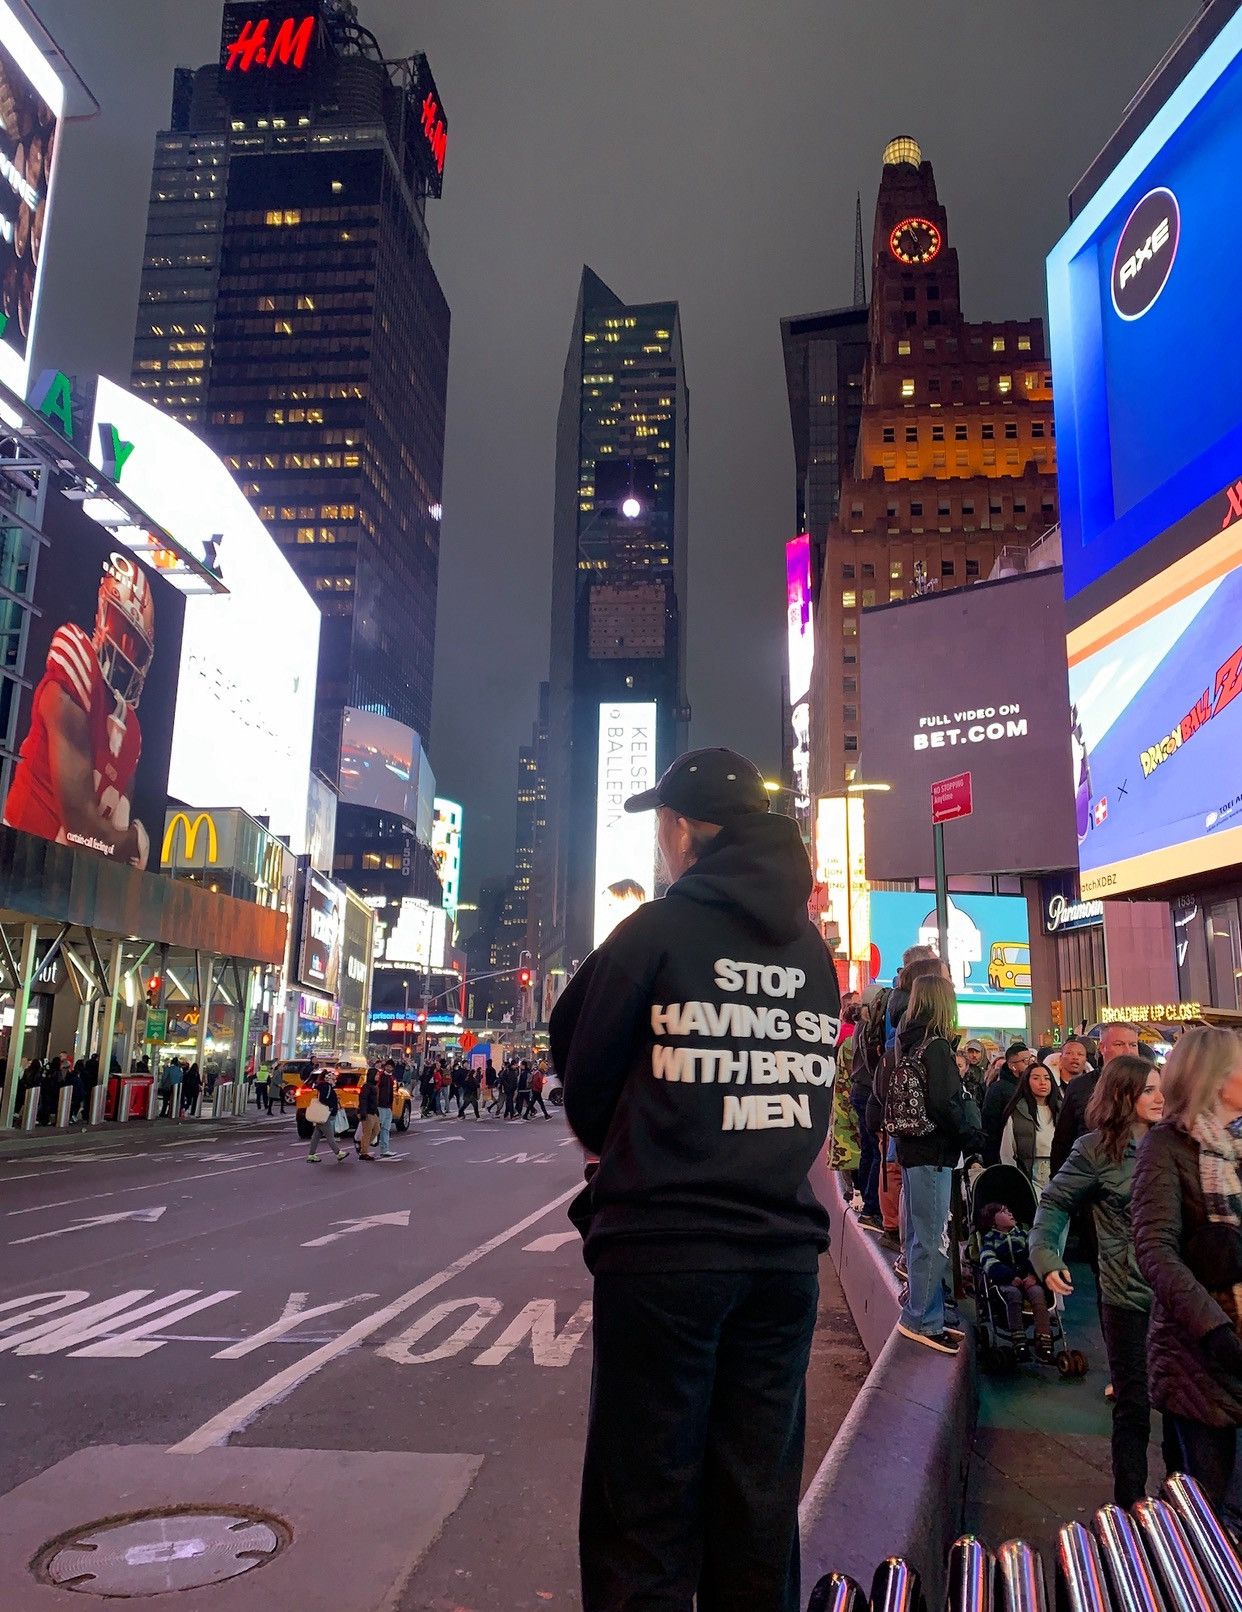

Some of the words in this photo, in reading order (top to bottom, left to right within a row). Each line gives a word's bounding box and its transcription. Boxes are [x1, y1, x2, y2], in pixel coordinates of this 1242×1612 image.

[225, 15, 316, 72] H&M
[1119, 217, 1170, 290] AXE
[913, 719, 1028, 750] BET.COM
[919, 715, 951, 728] FULL
[953, 706, 996, 723] VIDEO
[999, 703, 1020, 716] ON
[630, 727, 648, 796] KELSE
[1139, 723, 1183, 780] DRAGON
[933, 786, 941, 795] NO
[941, 779, 964, 793] STOPPING
[1047, 895, 1104, 931] Paramoun
[713, 957, 806, 999] STOP
[650, 1001, 792, 1041] HAVING
[794, 1010, 841, 1047] SE
[1101, 1006, 1149, 1024] BROADWAY
[1150, 1004, 1164, 1021] UP
[1165, 1002, 1201, 1020] CLOSE
[651, 1043, 749, 1085] WITH
[721, 1094, 813, 1131] MEN
